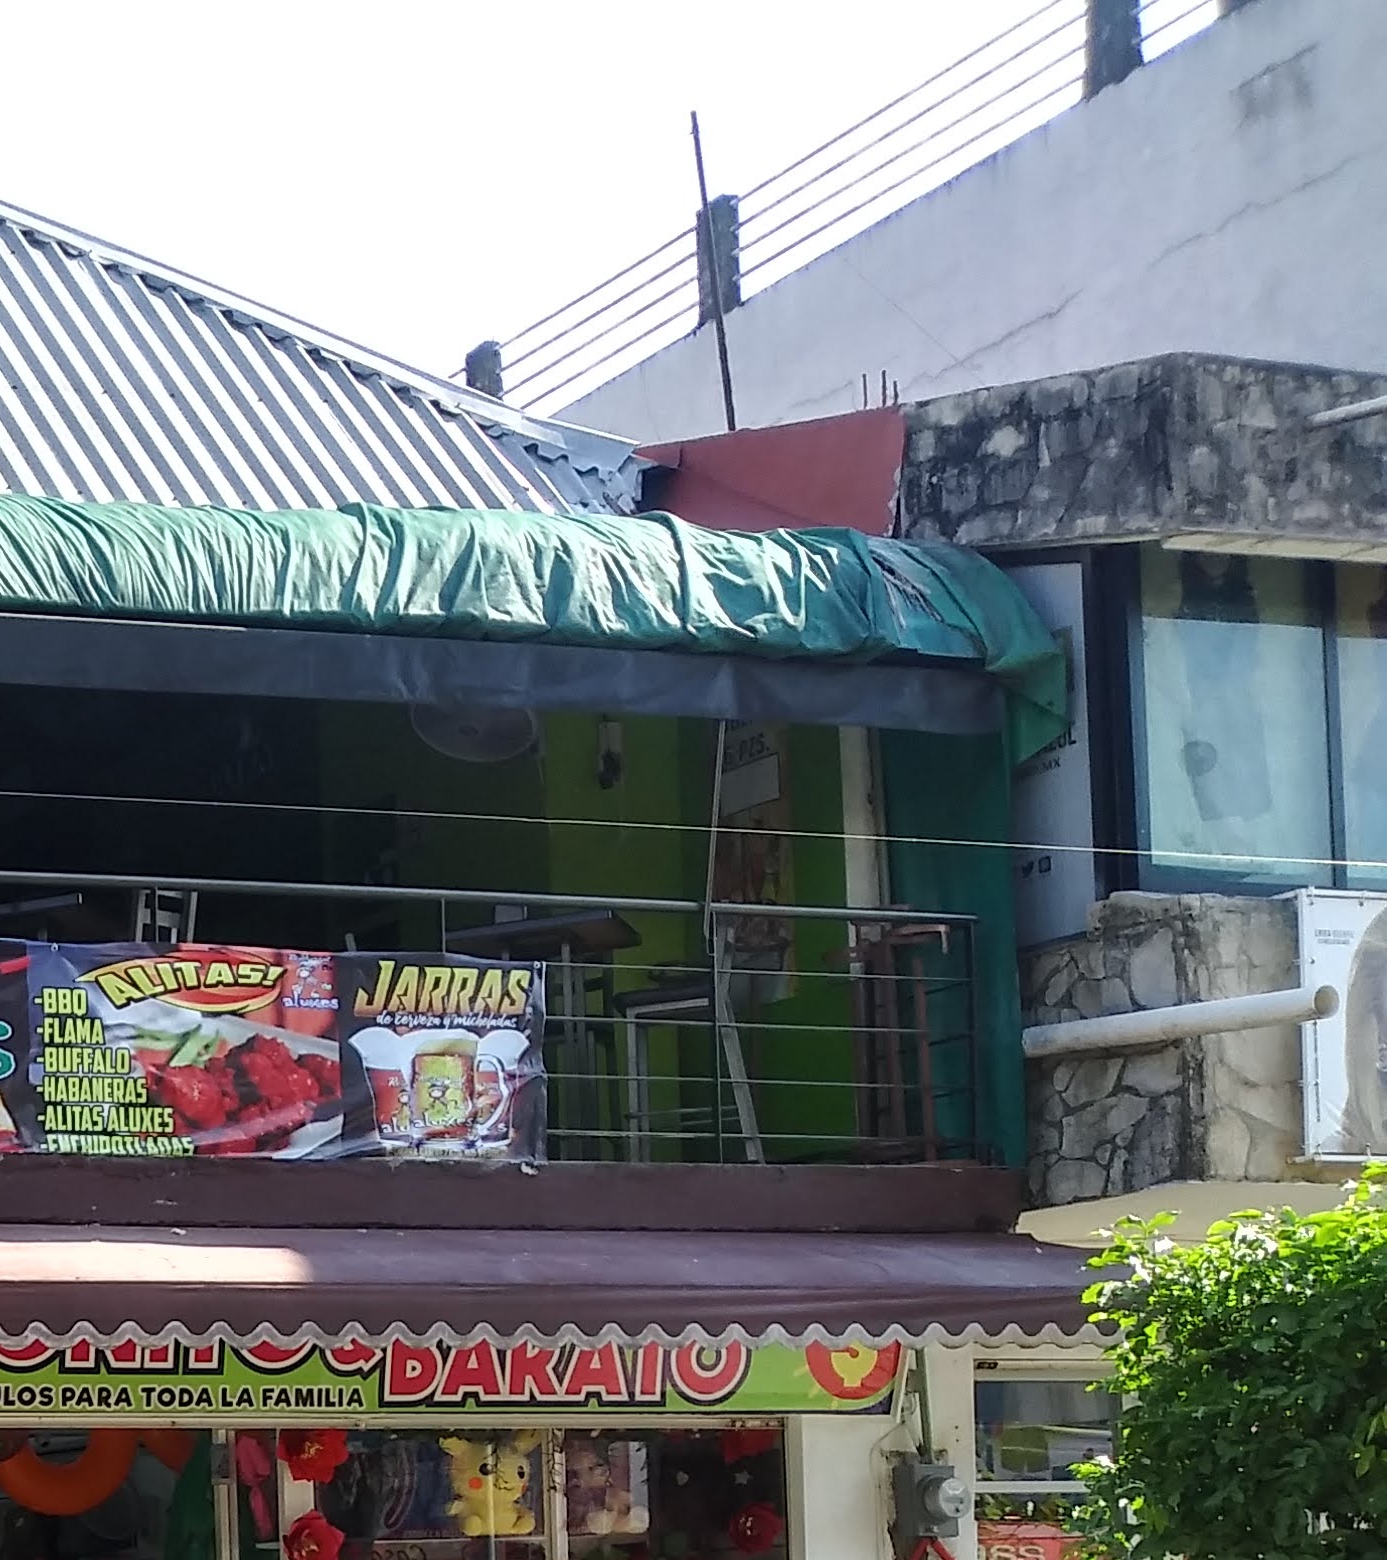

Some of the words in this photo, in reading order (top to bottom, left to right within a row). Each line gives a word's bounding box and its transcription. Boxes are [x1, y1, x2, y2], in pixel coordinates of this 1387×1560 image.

[96, 961, 287, 1009] ALITAS!
[354, 960, 532, 1017] JARRAS
[282, 996, 339, 1010] aluxes
[377, 1010, 392, 1024] de
[394, 1012, 442, 1027] cerveza
[443, 1014, 451, 1030] y
[107, 1107, 174, 1133] ALUXES
[61, 1386, 134, 1409] PARA
[141, 1386, 215, 1409] TODA
[220, 1386, 251, 1409] LA
[261, 1386, 365, 1409] FAMILIA
